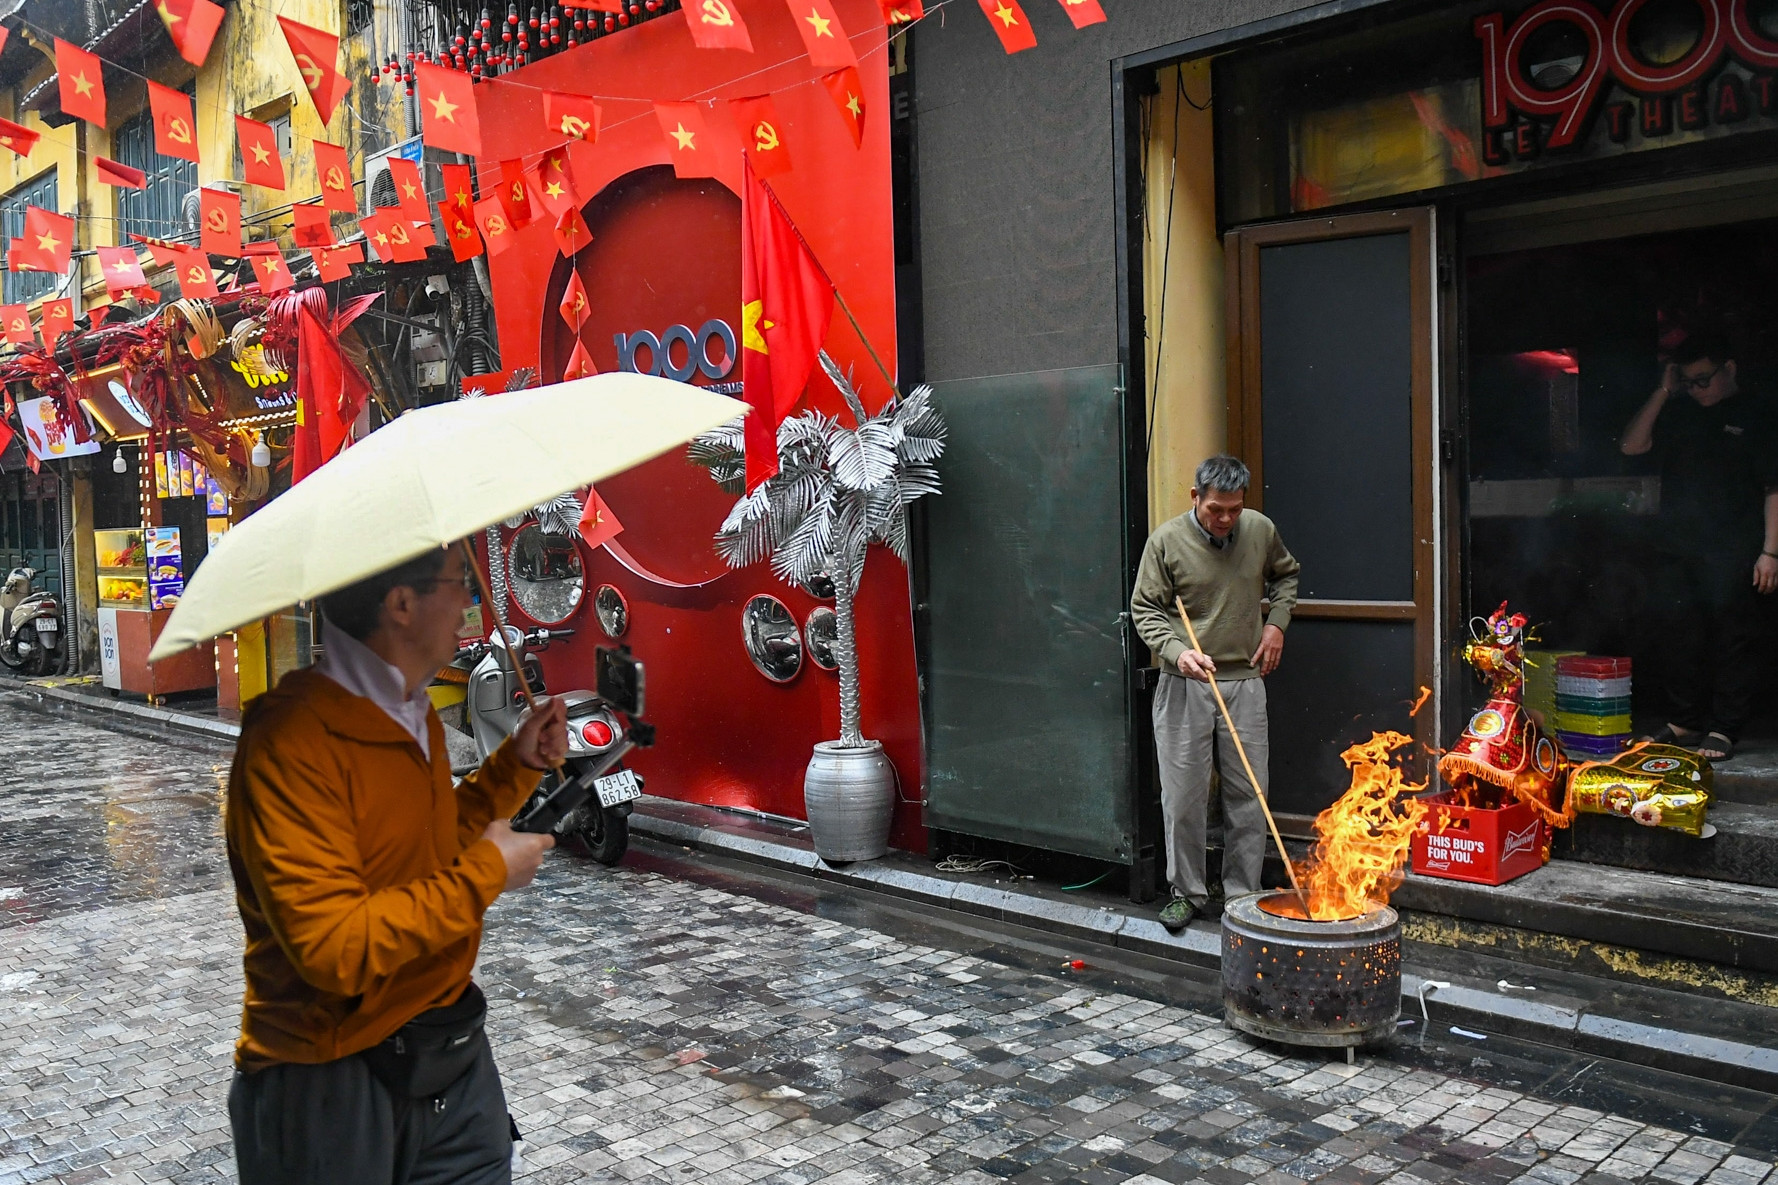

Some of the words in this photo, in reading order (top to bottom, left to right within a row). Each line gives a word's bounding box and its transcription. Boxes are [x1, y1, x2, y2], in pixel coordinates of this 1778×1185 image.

[1485, 124, 1532, 160] LE
[613, 318, 737, 382] 1000
[600, 772, 630, 792] 29-L1
[601, 784, 639, 805] 862.58
[1427, 835, 1451, 848] THIS
[1453, 838, 1484, 853] BUD'S
[1427, 846, 1448, 860] FOR
[1449, 850, 1473, 864] YOU.
